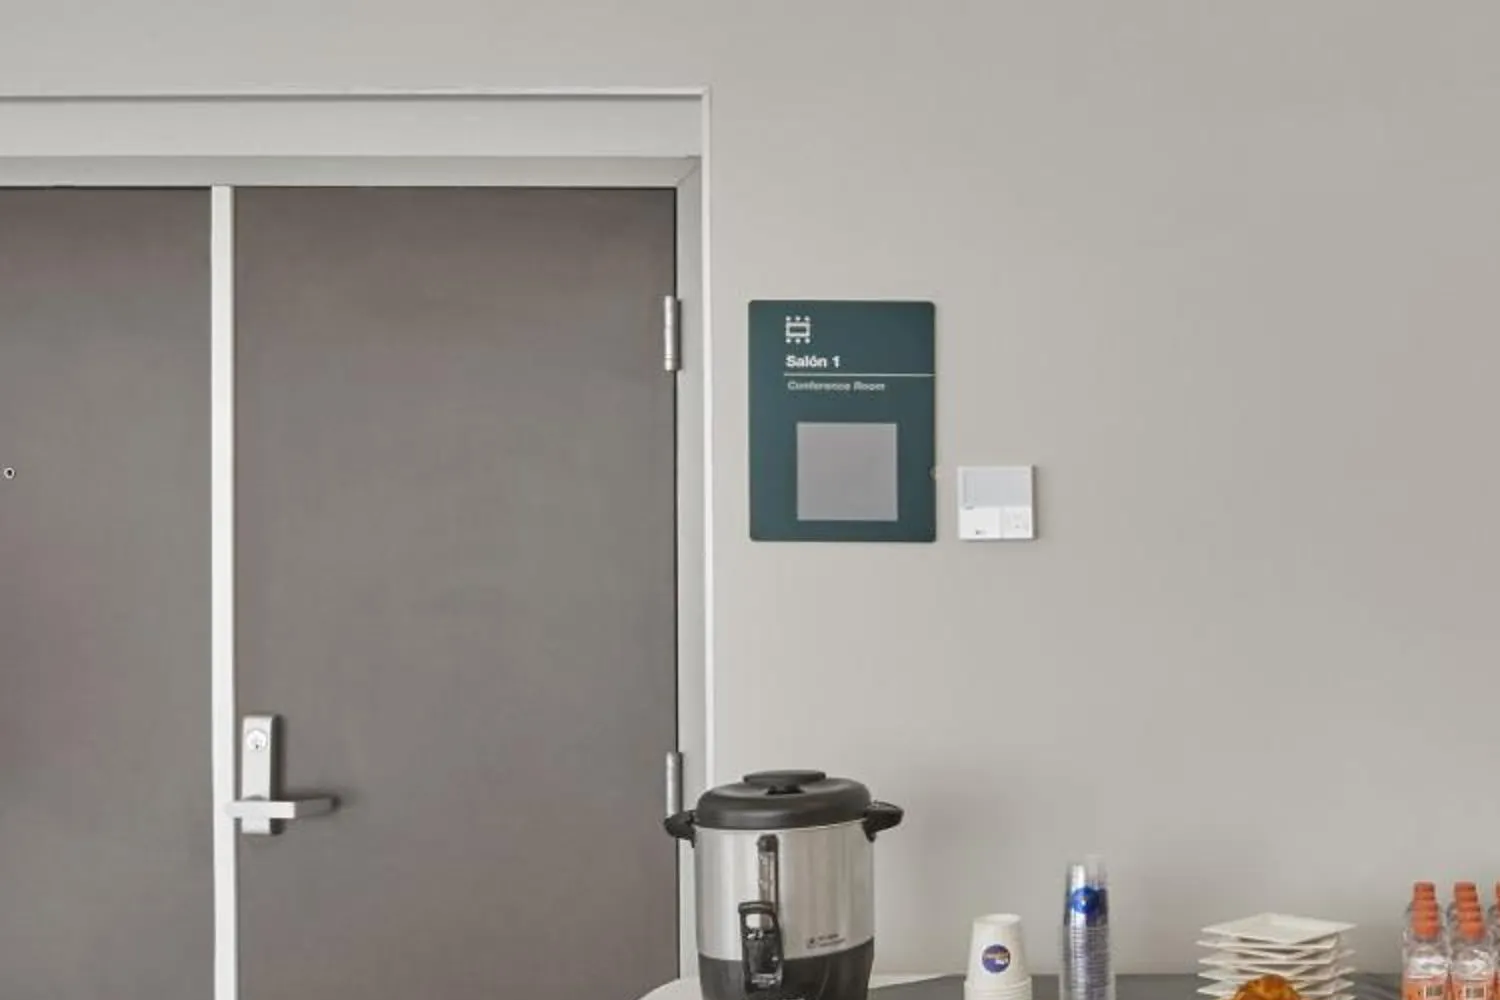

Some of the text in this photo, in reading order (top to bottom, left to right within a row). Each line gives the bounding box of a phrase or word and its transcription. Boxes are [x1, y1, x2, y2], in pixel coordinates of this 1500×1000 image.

[786, 355, 840, 368] Salón 1
[787, 380, 886, 391] Conference Room
